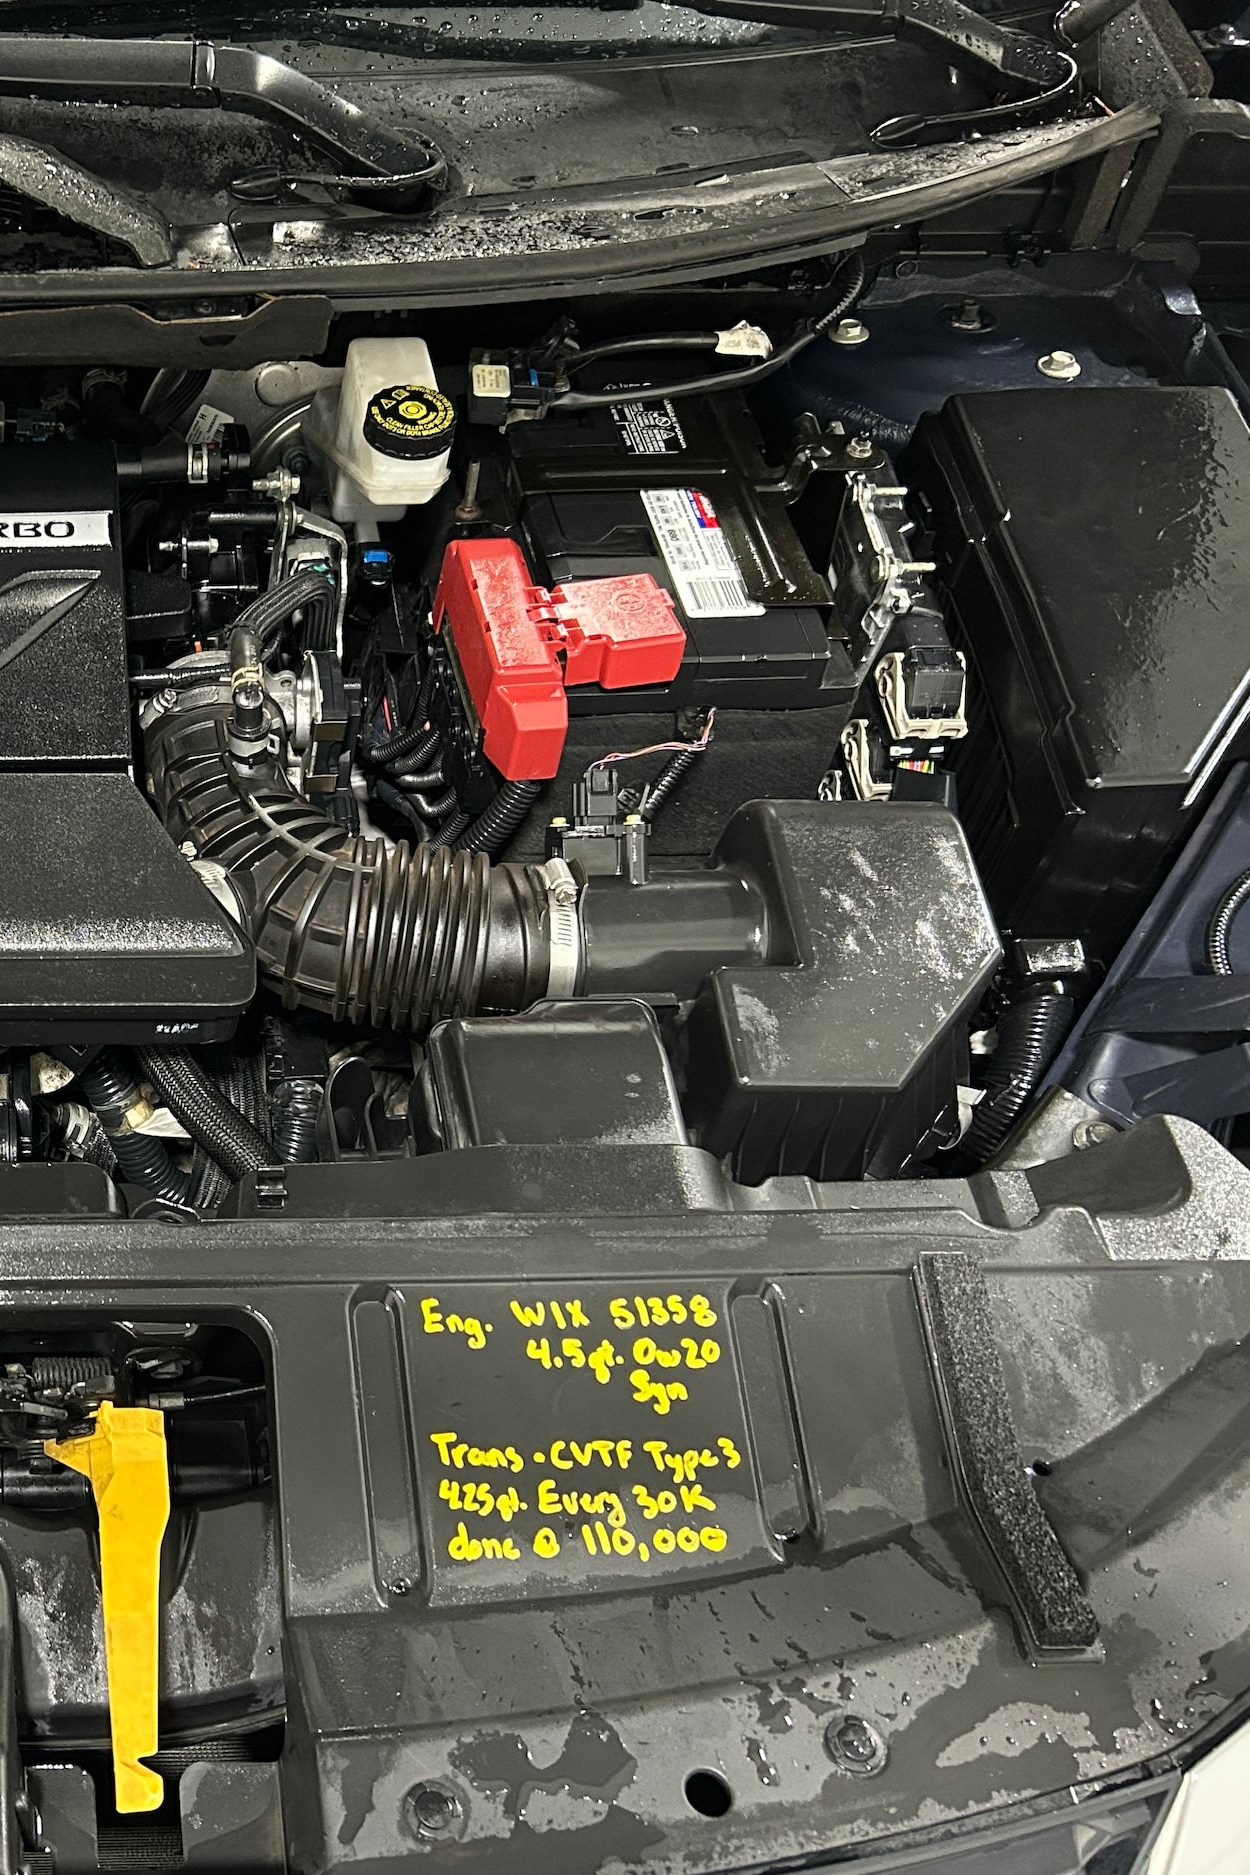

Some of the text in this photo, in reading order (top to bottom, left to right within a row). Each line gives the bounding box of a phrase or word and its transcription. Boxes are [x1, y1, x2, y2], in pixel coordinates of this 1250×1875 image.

[386, 417, 403, 429] CLEAN
[420, 1294, 718, 1350] Eng. WIX 51358
[628, 1368, 689, 1415] Syn
[549, 1439, 633, 1470] CVTF
[537, 1478, 627, 1529] Every
[447, 1521, 522, 1562] done
[580, 1520, 729, 1564] 110,000
